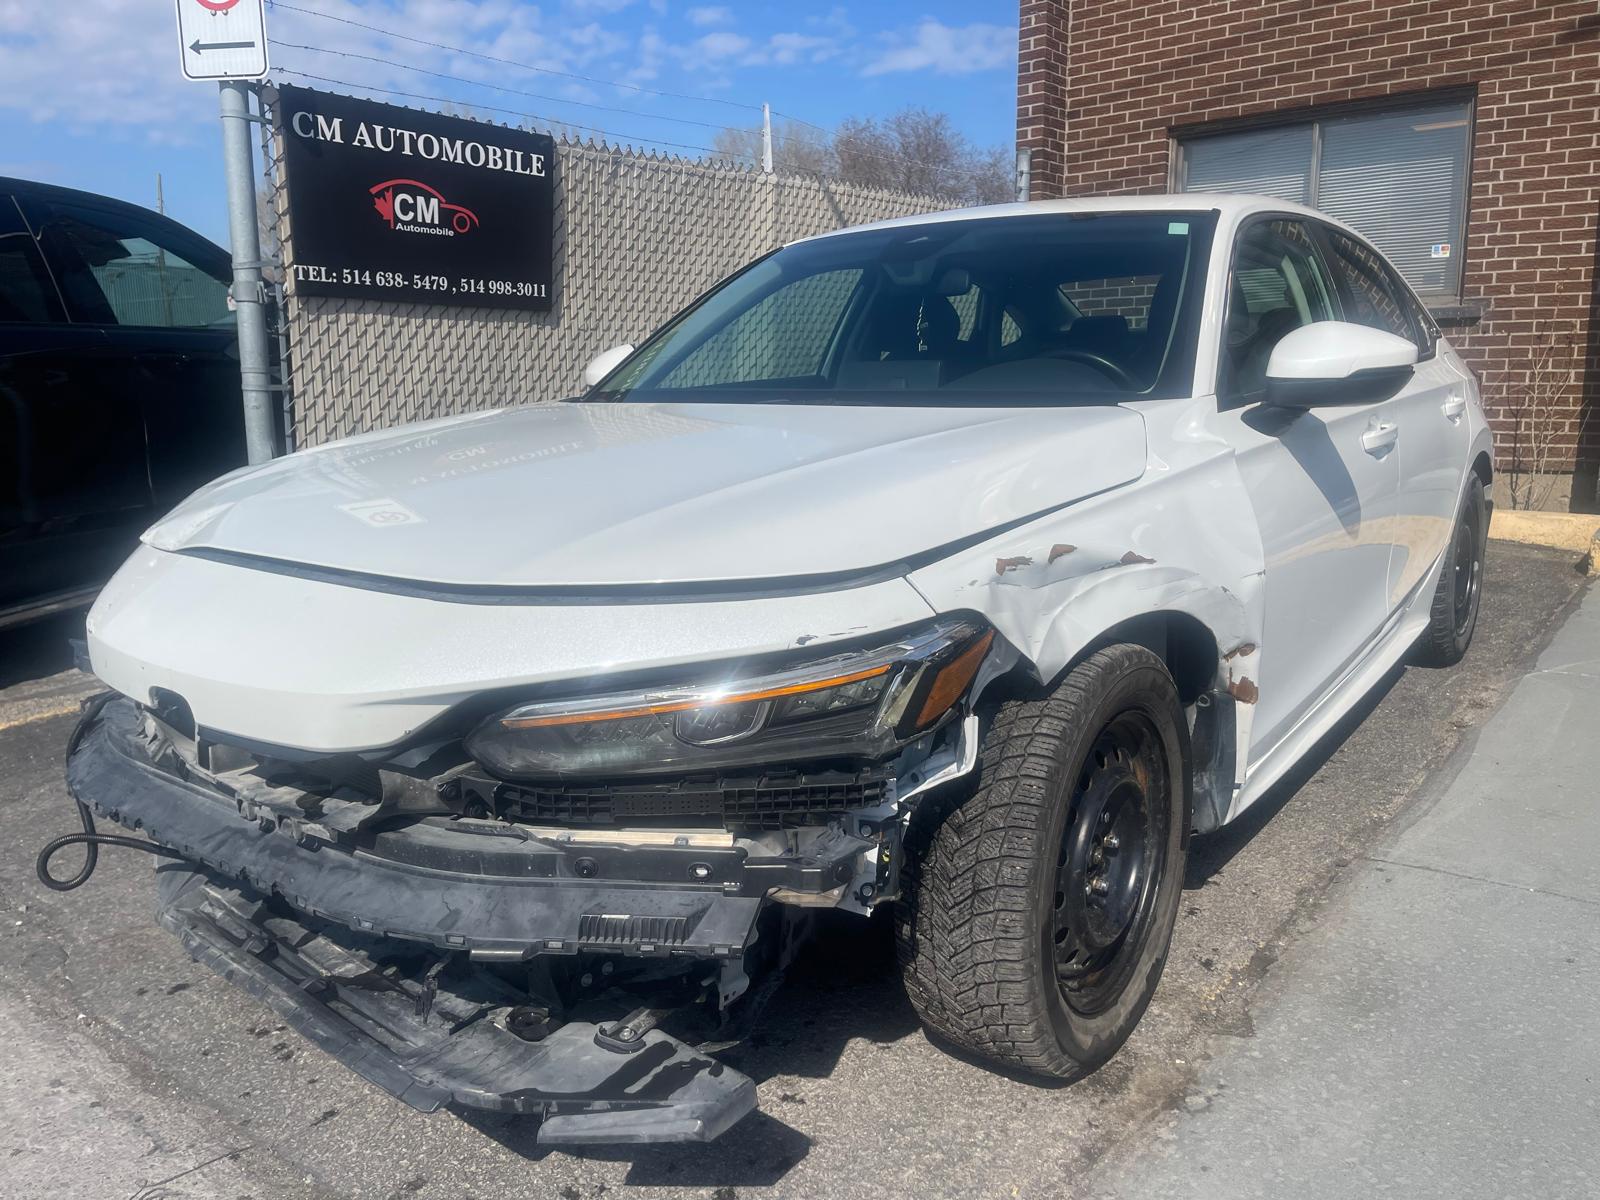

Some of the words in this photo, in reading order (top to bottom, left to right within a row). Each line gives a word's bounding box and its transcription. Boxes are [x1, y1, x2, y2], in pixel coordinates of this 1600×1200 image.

[292, 111, 344, 144] CM
[352, 121, 546, 177] AUTOMOBILE
[394, 193, 440, 225] CM
[395, 222, 455, 237] Automobile
[293, 264, 337, 283] TEL:
[342, 268, 372, 286] 514
[375, 271, 409, 288] 638-
[413, 274, 448, 291] 5479
[488, 280, 546, 298] 998-3011
